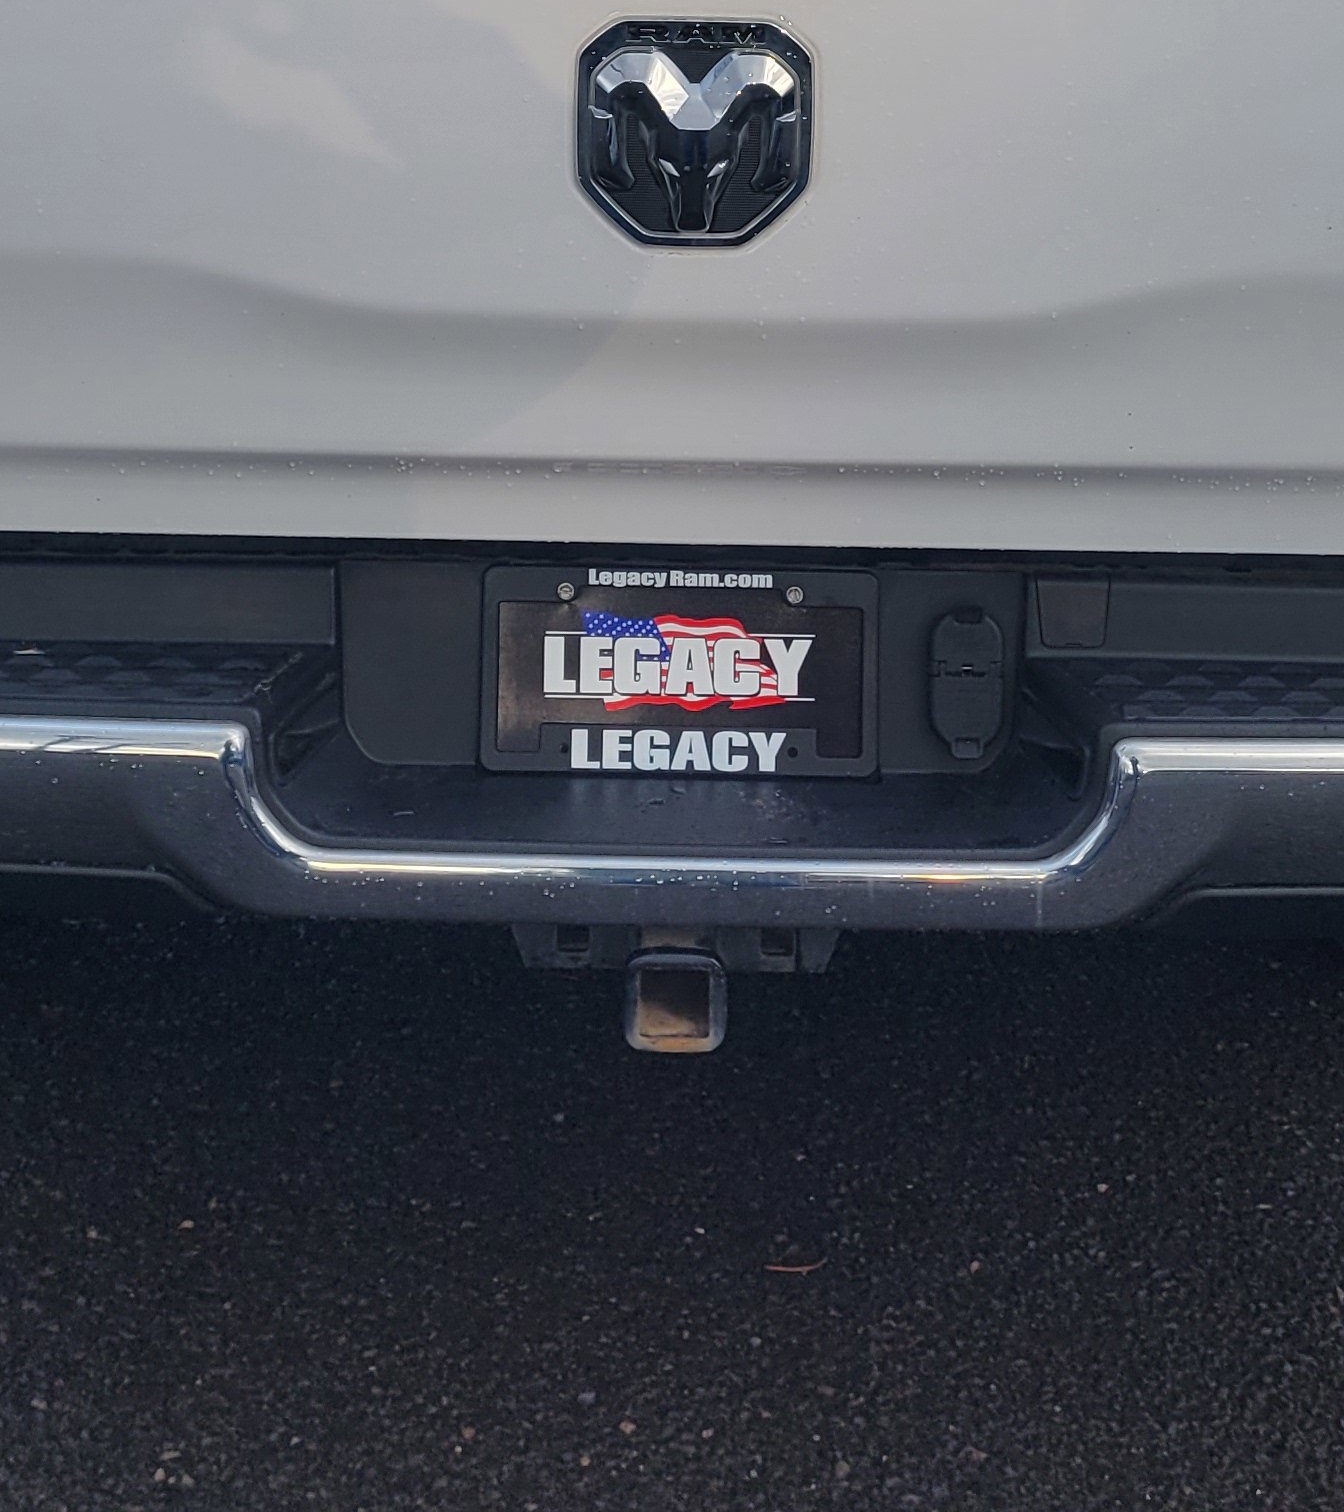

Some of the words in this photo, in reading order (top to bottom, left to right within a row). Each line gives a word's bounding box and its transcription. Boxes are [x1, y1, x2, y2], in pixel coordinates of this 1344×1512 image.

[625, 23, 767, 44] RAM
[543, 636, 813, 696] LEGACY
[570, 728, 788, 773] LEGACY
